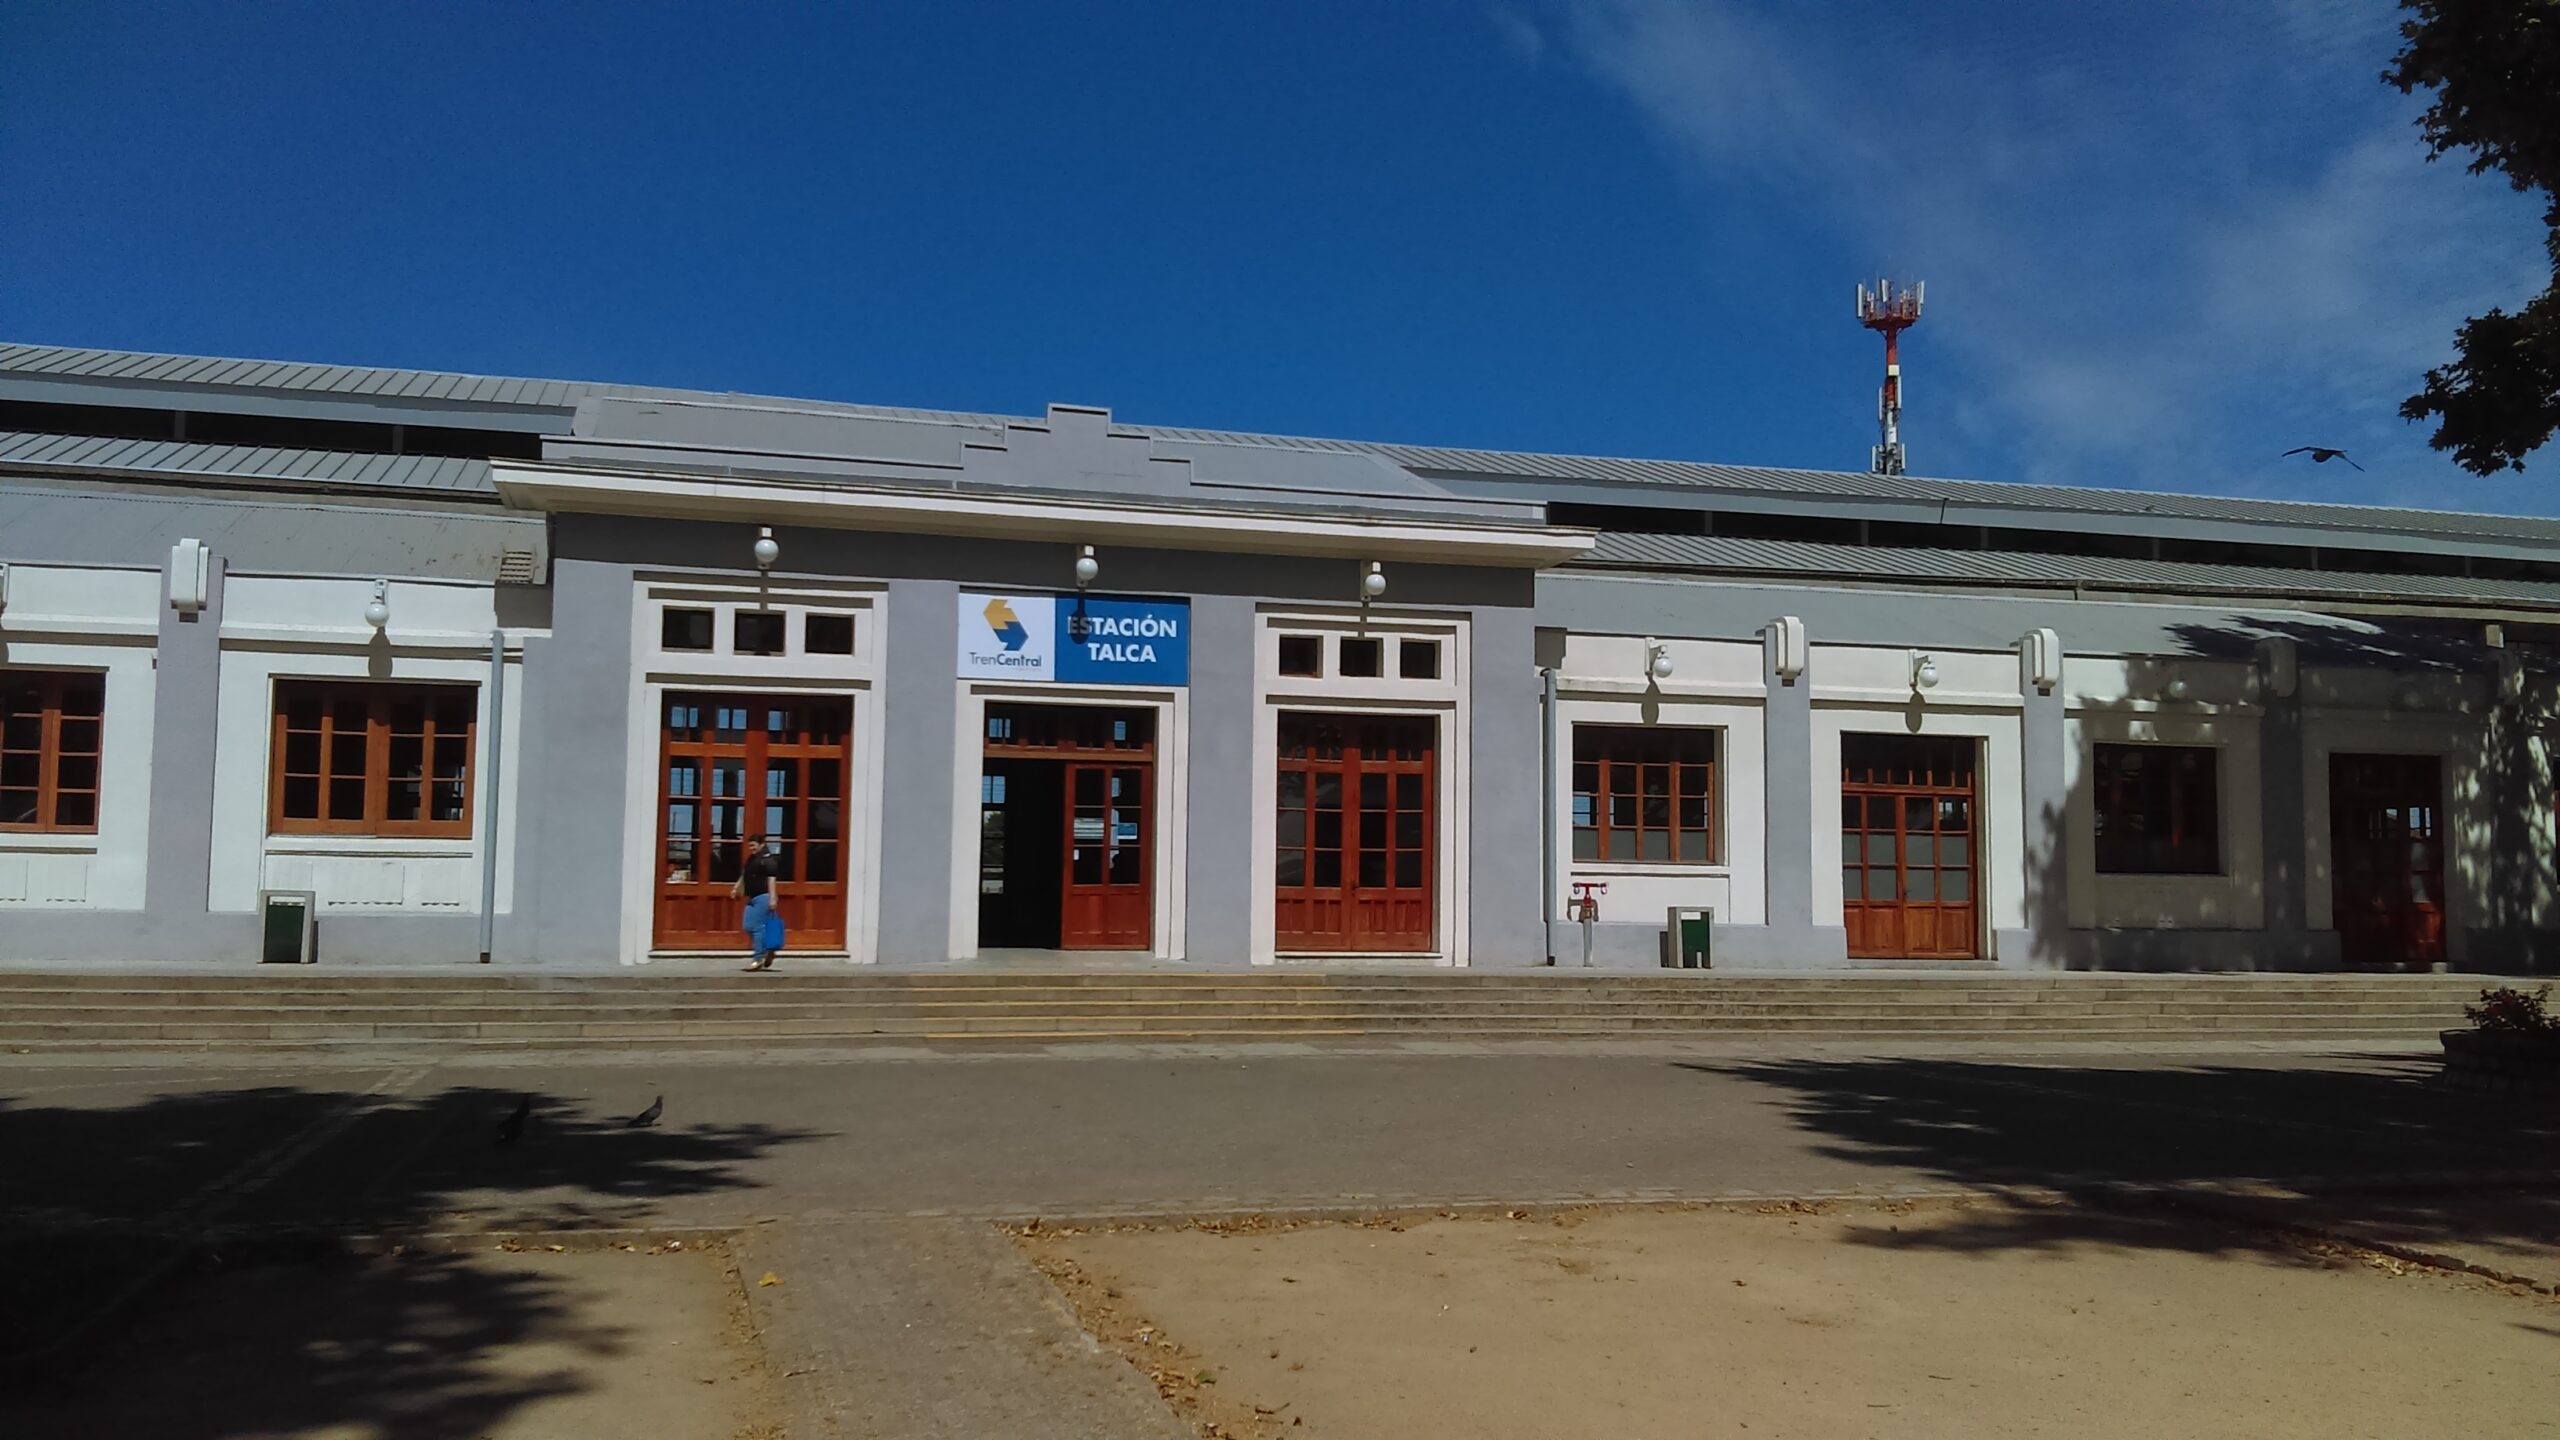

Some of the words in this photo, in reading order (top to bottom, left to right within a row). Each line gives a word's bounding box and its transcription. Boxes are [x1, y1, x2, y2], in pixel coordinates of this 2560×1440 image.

[1067, 614, 1177, 637] ESTACIÓN
[969, 651, 1042, 667] TrenCentral
[1087, 643, 1157, 662] TALCA
